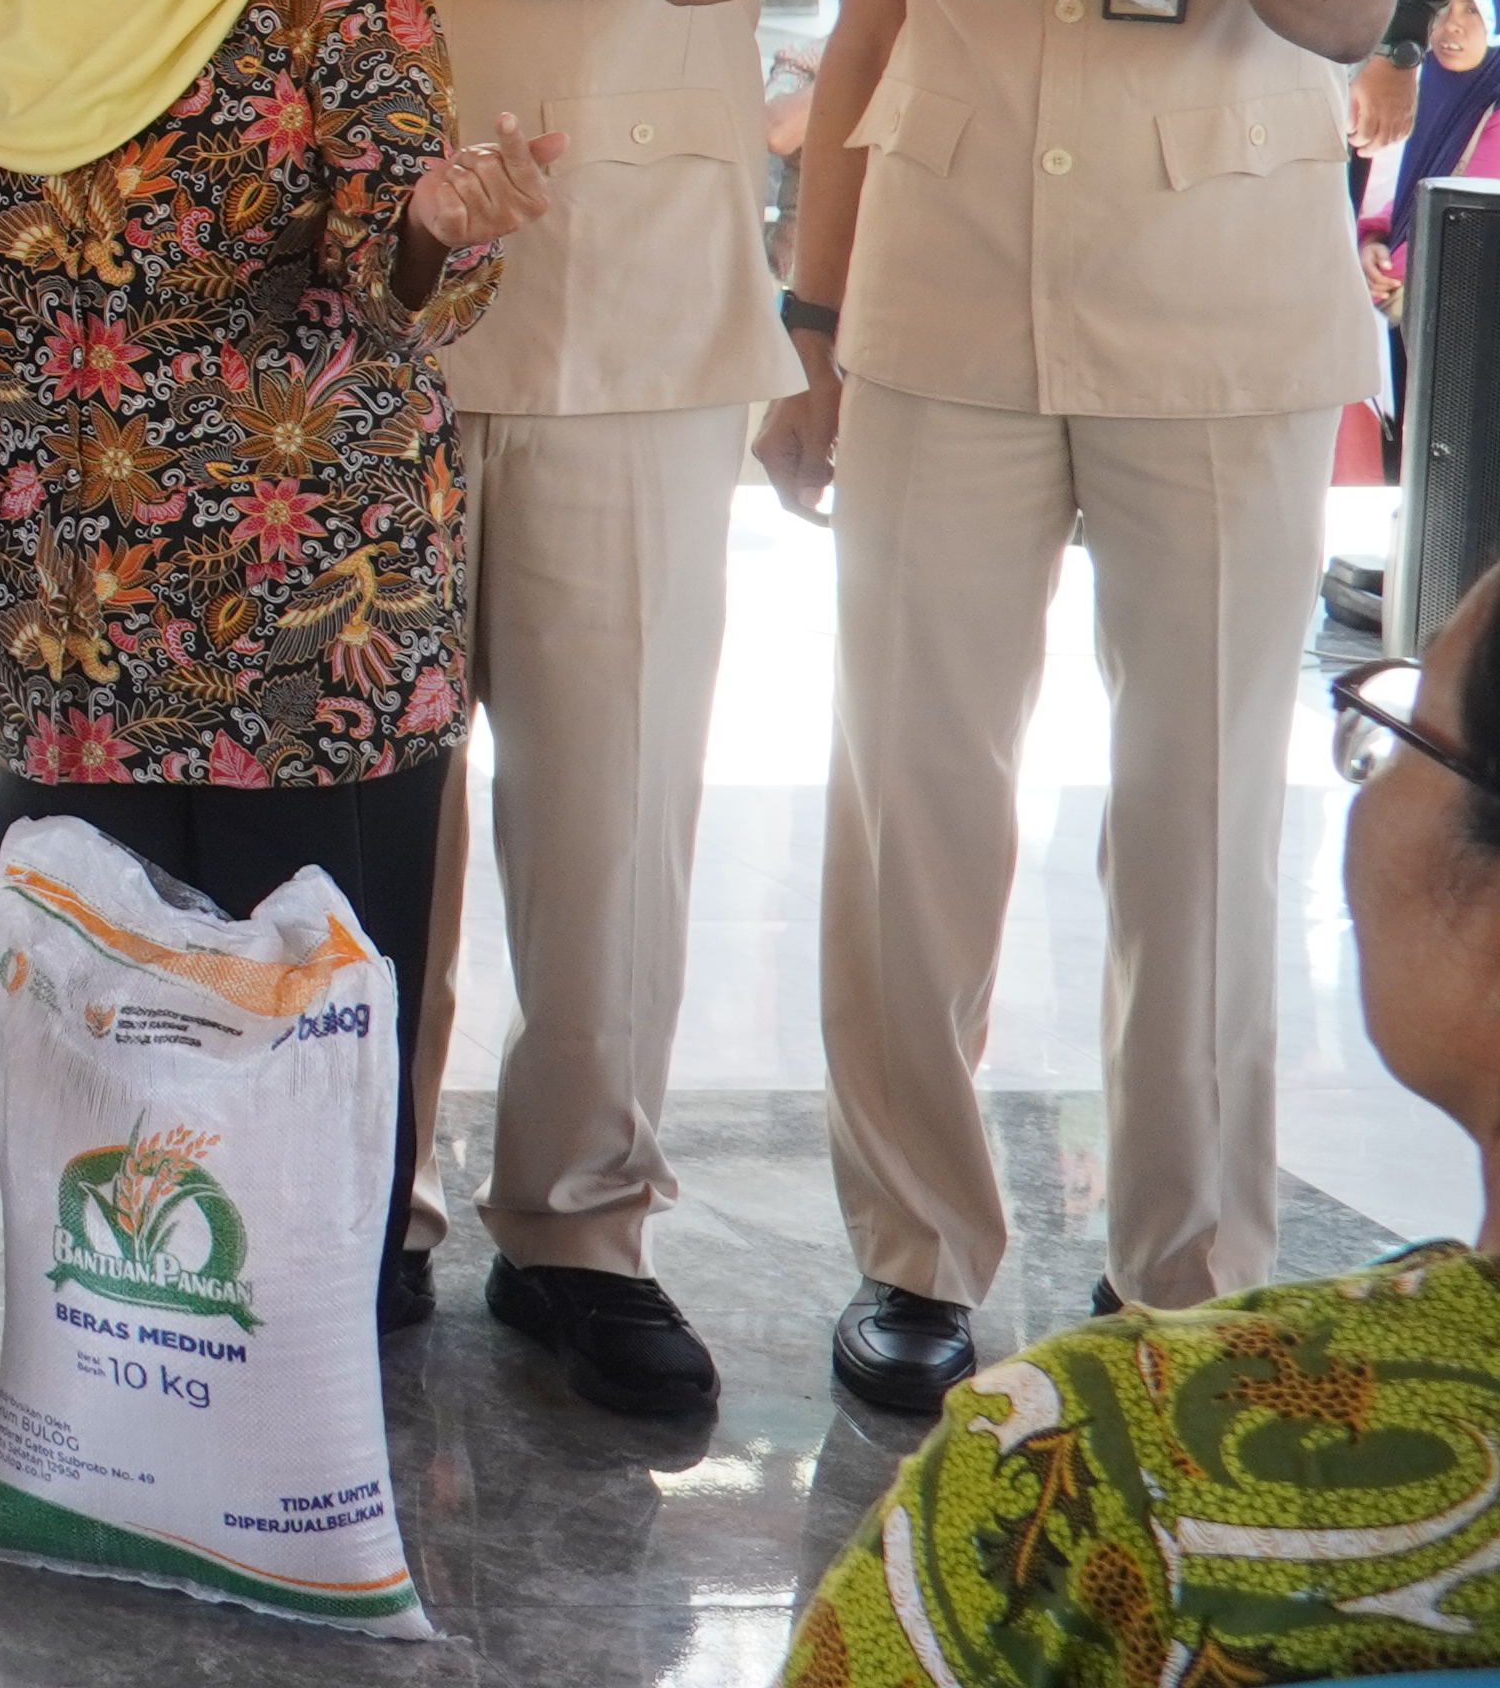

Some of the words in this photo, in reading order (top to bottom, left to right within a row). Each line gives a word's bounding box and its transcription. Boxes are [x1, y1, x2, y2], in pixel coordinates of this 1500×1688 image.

[298, 1003, 370, 1041] bulog
[52, 1224, 150, 1284] BANTUAN
[152, 1252, 253, 1304] PANGAN
[56, 1302, 130, 1340] BERAS
[138, 1325, 247, 1363] MEDIUM
[108, 1357, 147, 1390] 10
[160, 1365, 210, 1409] kg
[22, 1416, 79, 1452] BULOG
[44, 1414, 71, 1432] Oleh
[25, 1438, 55, 1461] Gatot
[58, 1451, 108, 1475] Subroto
[111, 1468, 134, 1481] No.
[138, 1473, 155, 1484] 49
[280, 1493, 334, 1512] TIDAK
[338, 1480, 382, 1504] UNTUK
[224, 1501, 384, 1533] DIPERJUALBELIKAN
